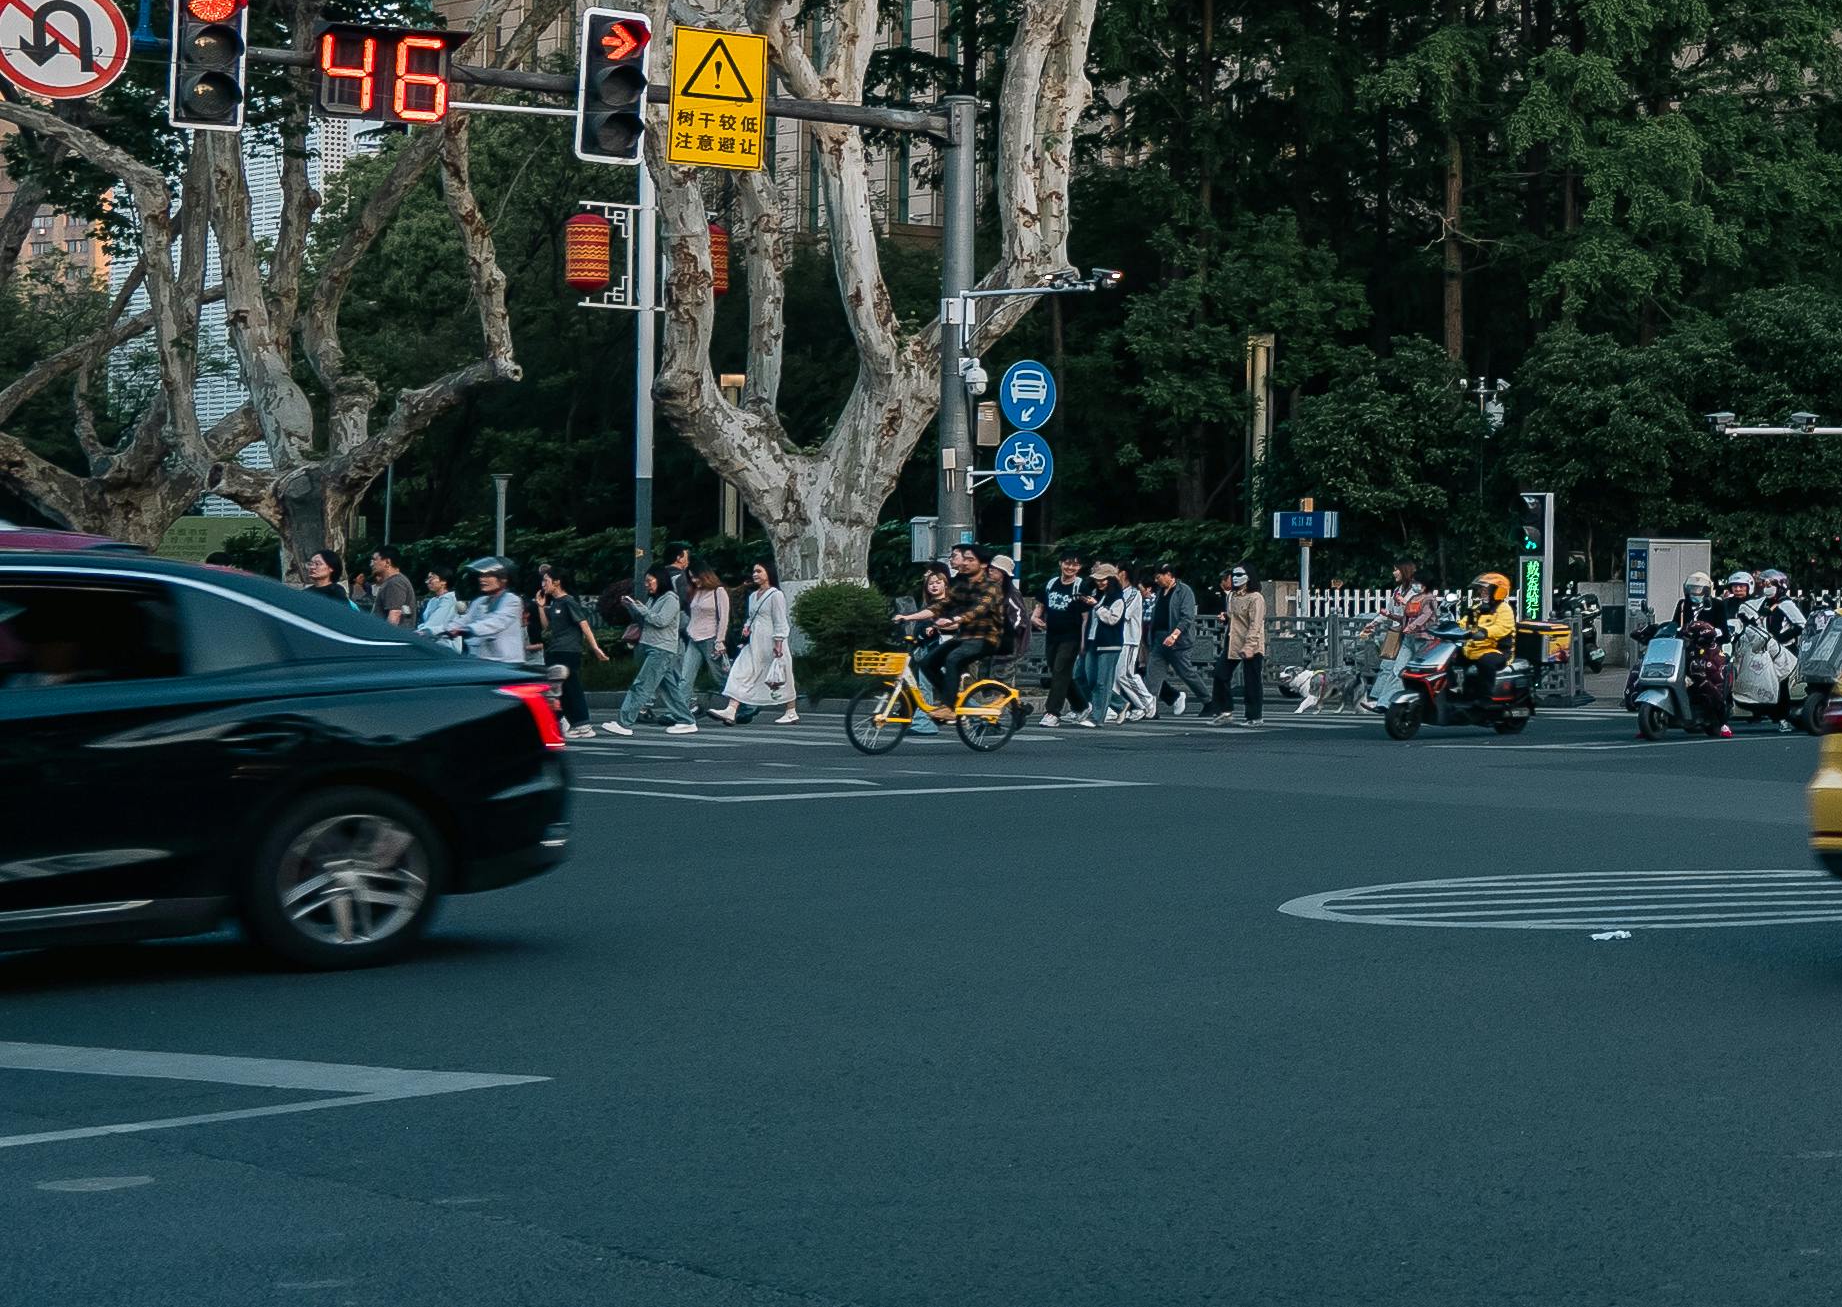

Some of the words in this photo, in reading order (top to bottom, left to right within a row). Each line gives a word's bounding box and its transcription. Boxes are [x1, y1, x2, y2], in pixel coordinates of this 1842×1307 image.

[322, 34, 447, 121] 46
[676, 109, 758, 134] 树干较低
[674, 131, 757, 156] 注意避让
